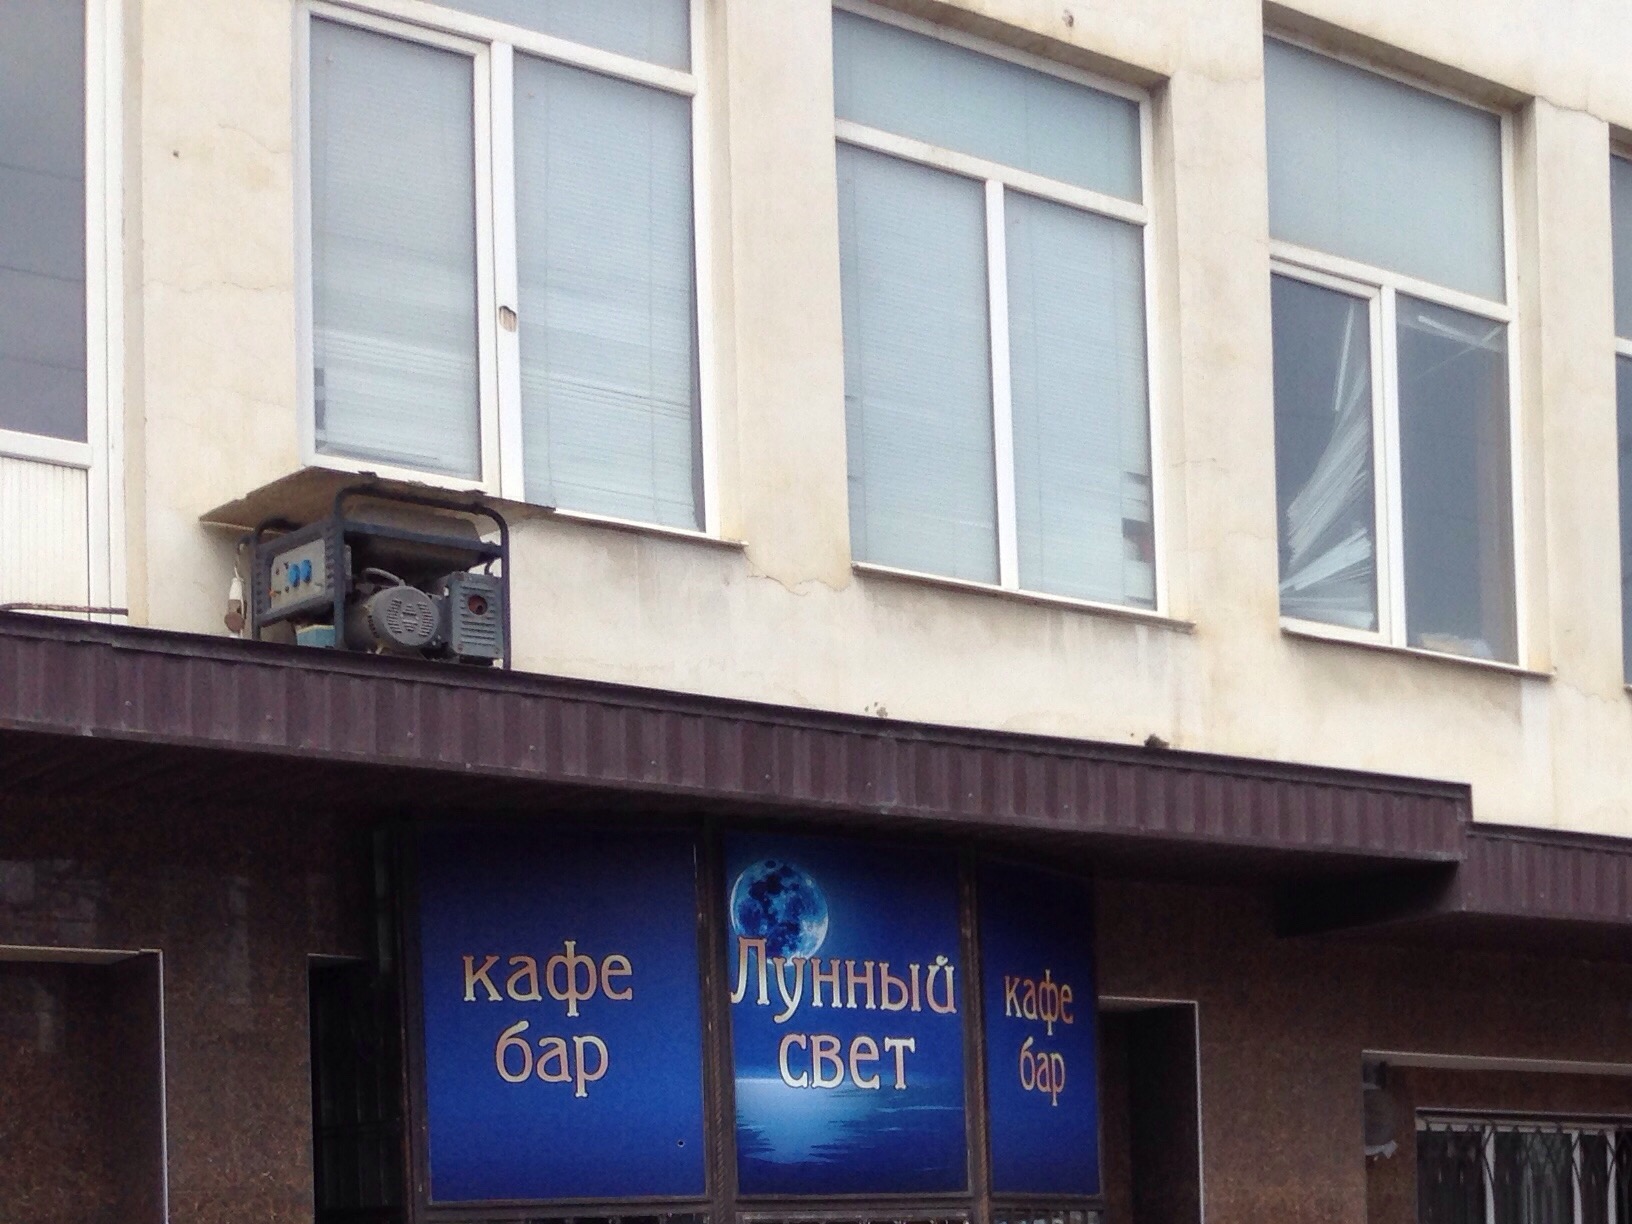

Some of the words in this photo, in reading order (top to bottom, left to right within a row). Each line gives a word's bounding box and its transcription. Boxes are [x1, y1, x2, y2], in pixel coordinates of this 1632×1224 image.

[462, 940, 634, 1017] кафе
[730, 936, 958, 1024] Лунный
[1004, 969, 1075, 1036] кафе
[494, 1020, 609, 1098] бар
[778, 1032, 917, 1090] свет
[1018, 1036, 1066, 1107] бар
